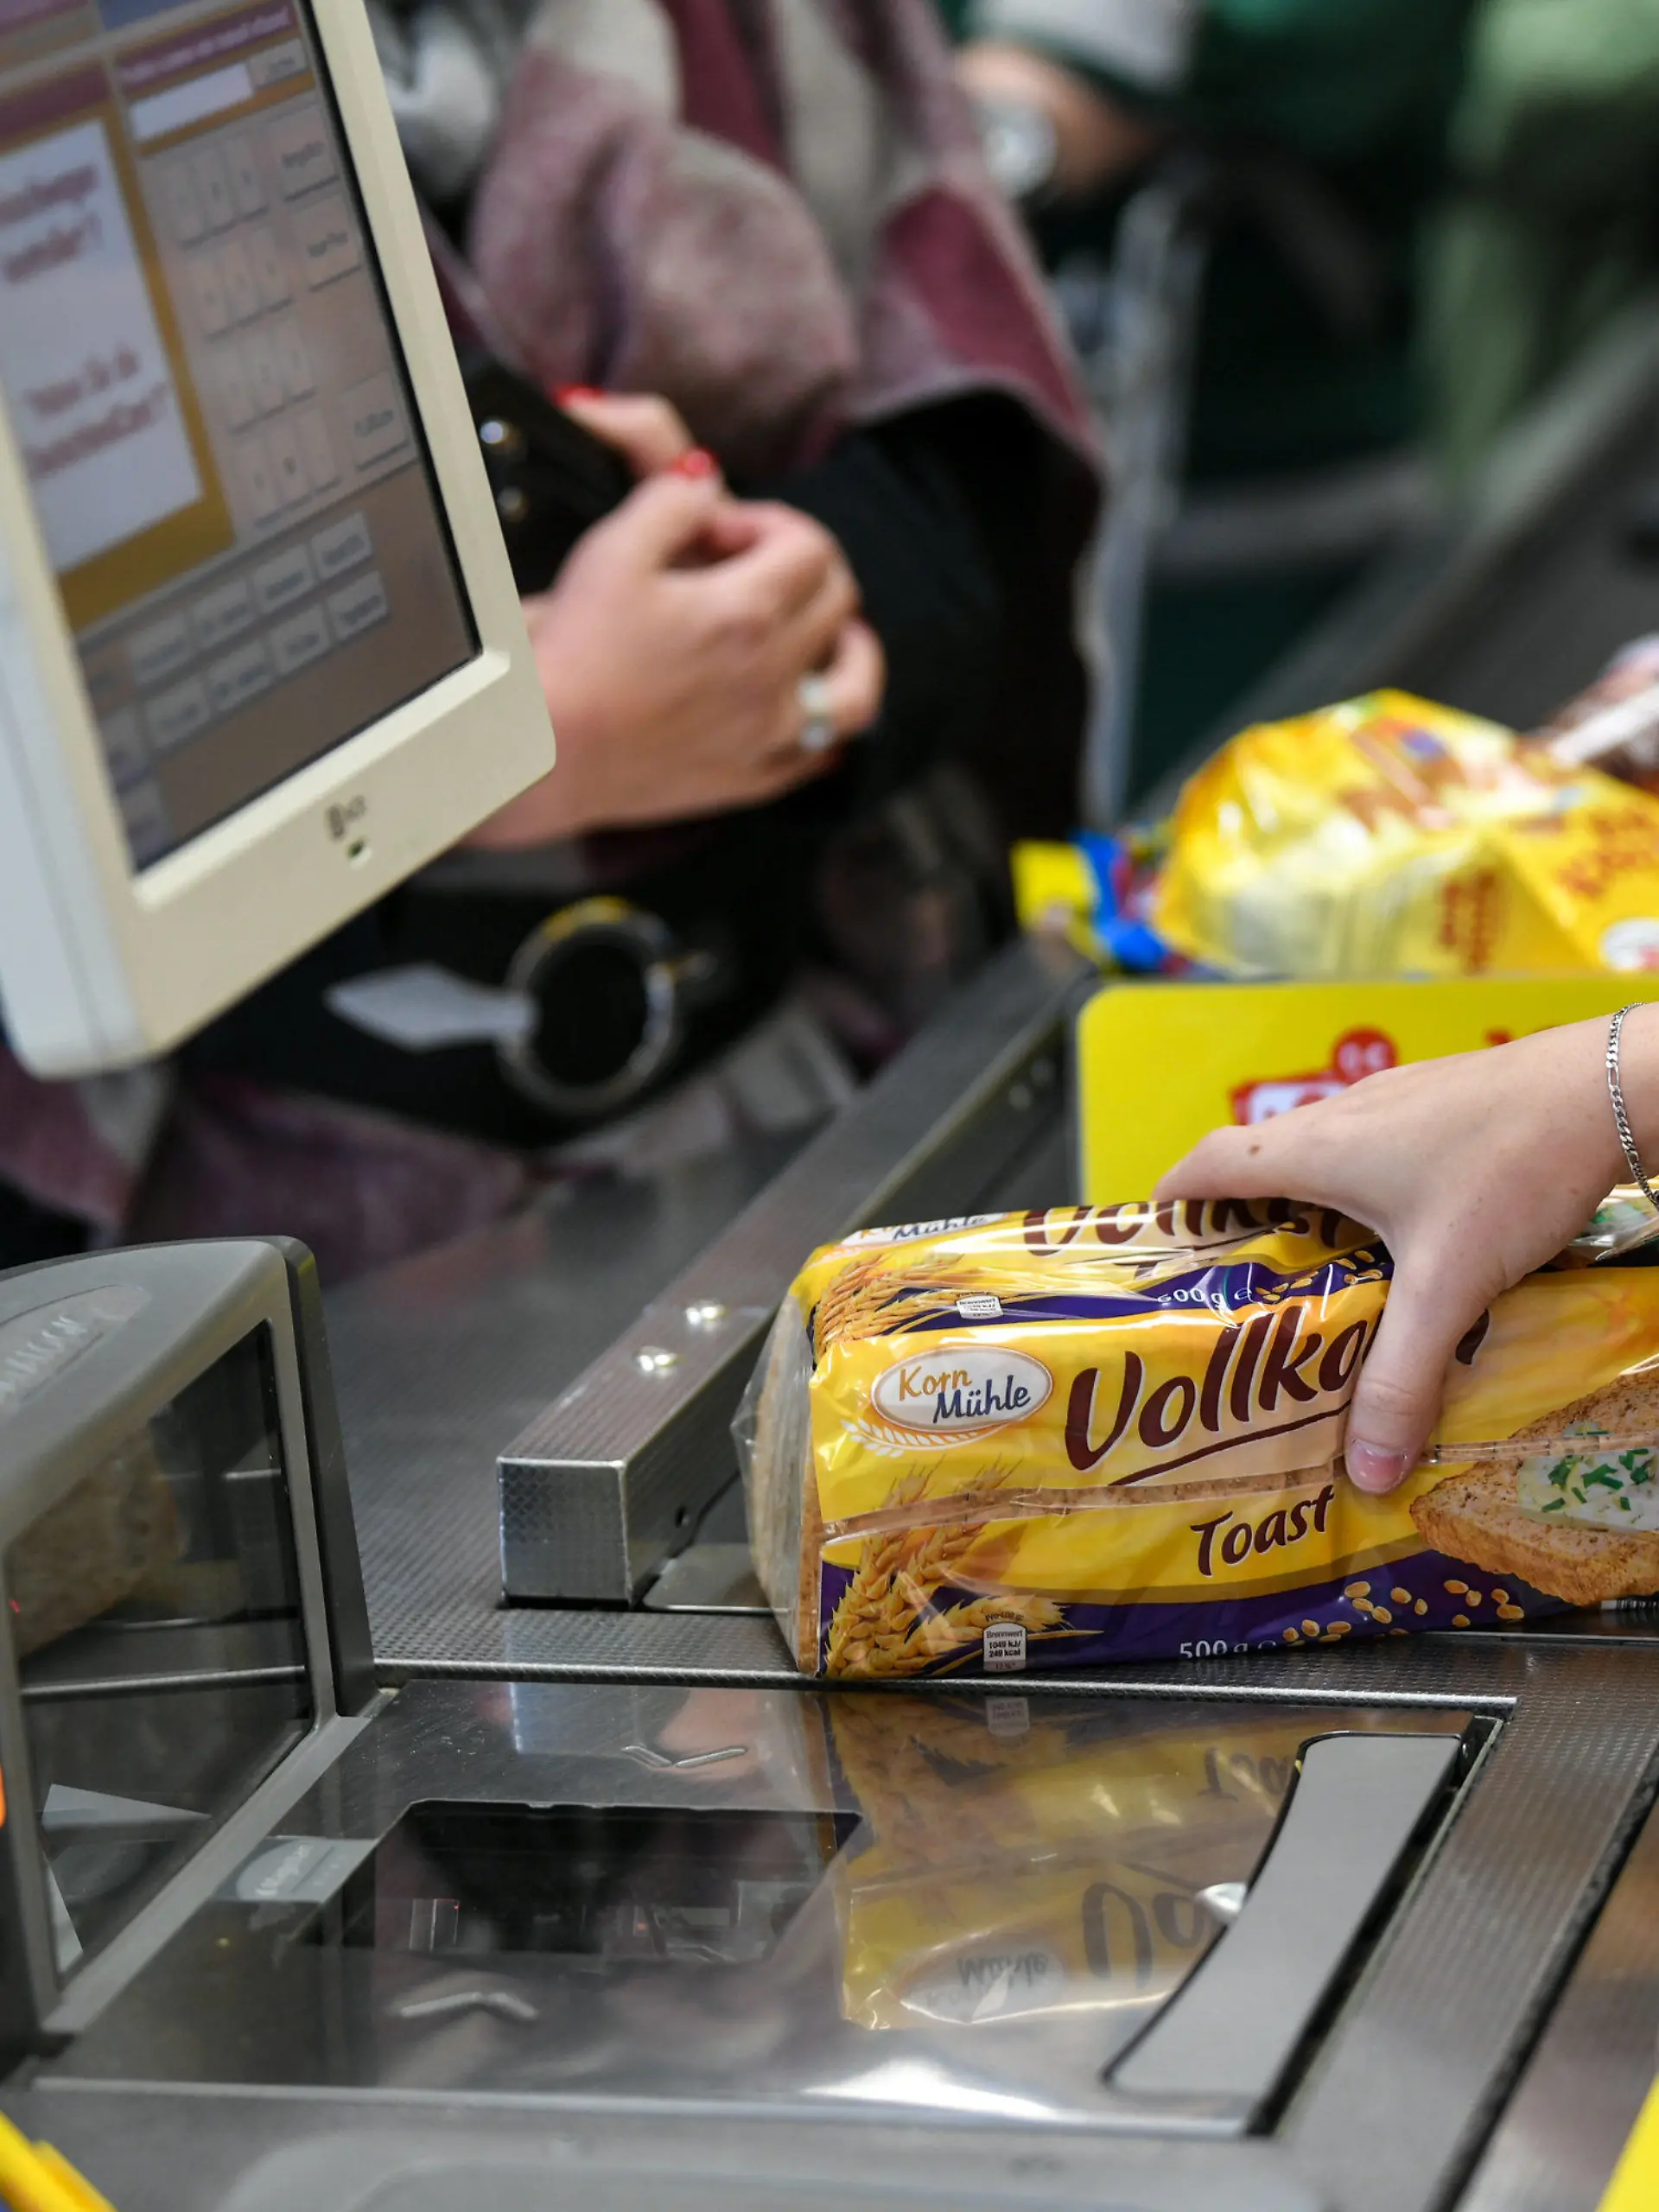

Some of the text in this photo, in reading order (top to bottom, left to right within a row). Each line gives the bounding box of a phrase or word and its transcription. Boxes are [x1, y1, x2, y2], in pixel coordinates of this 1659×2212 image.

[899, 1365, 972, 1402] Korn
[932, 1375, 1031, 1424] Mühle
[1065, 1306, 1490, 1471] Vollko
[1190, 1484, 1336, 1576] Toast
[986, 1630, 1023, 1638] Brennwert
[1179, 1639, 1227, 1659] 500
